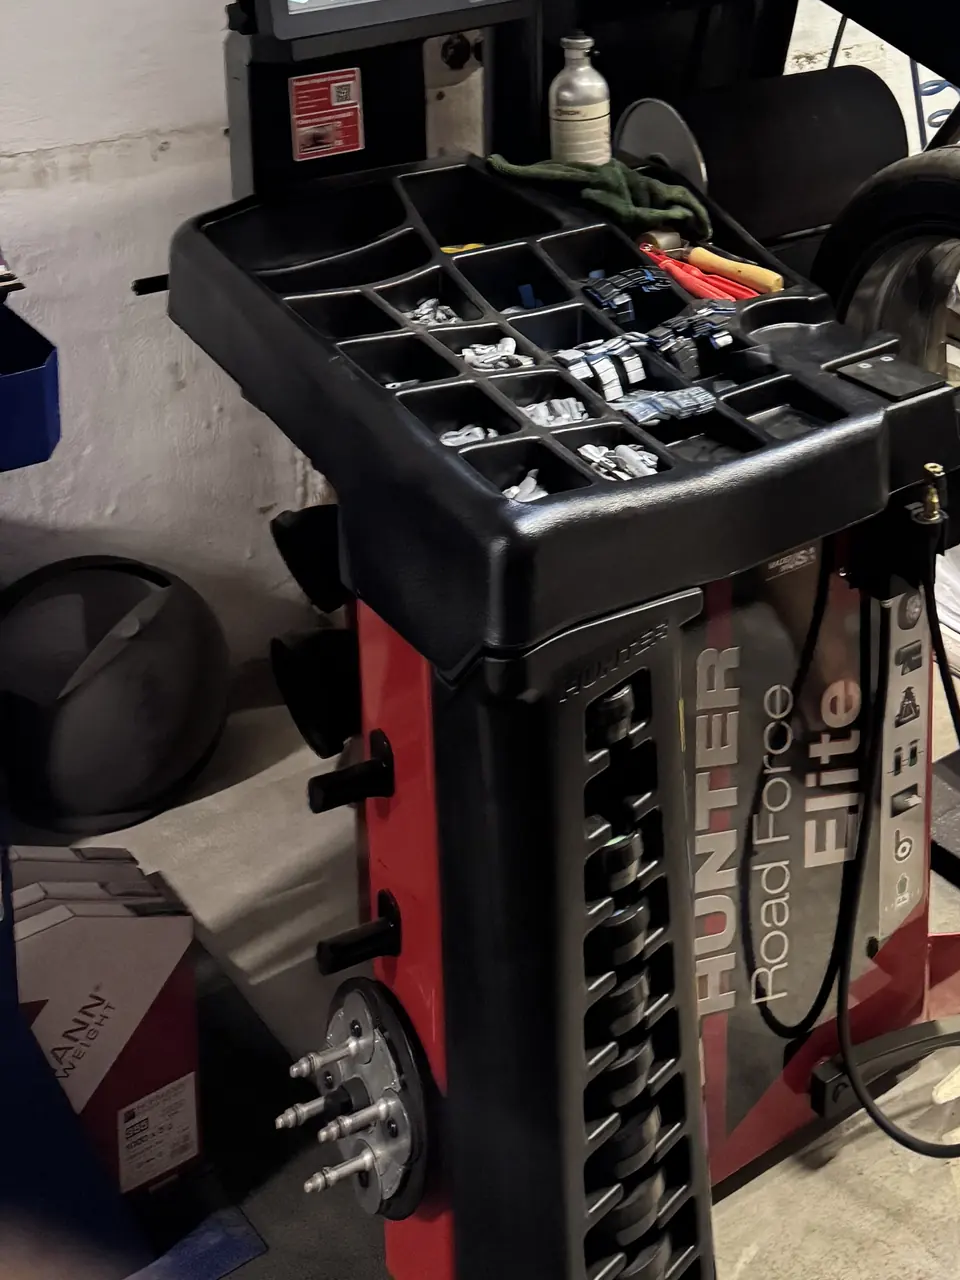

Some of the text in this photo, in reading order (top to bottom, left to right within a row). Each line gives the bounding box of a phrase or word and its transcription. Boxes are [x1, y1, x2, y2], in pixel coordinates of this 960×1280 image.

[695, 645, 741, 1017] HUNTER
[751, 683, 794, 1005] Road Force
[804, 679, 863, 869] Elite
